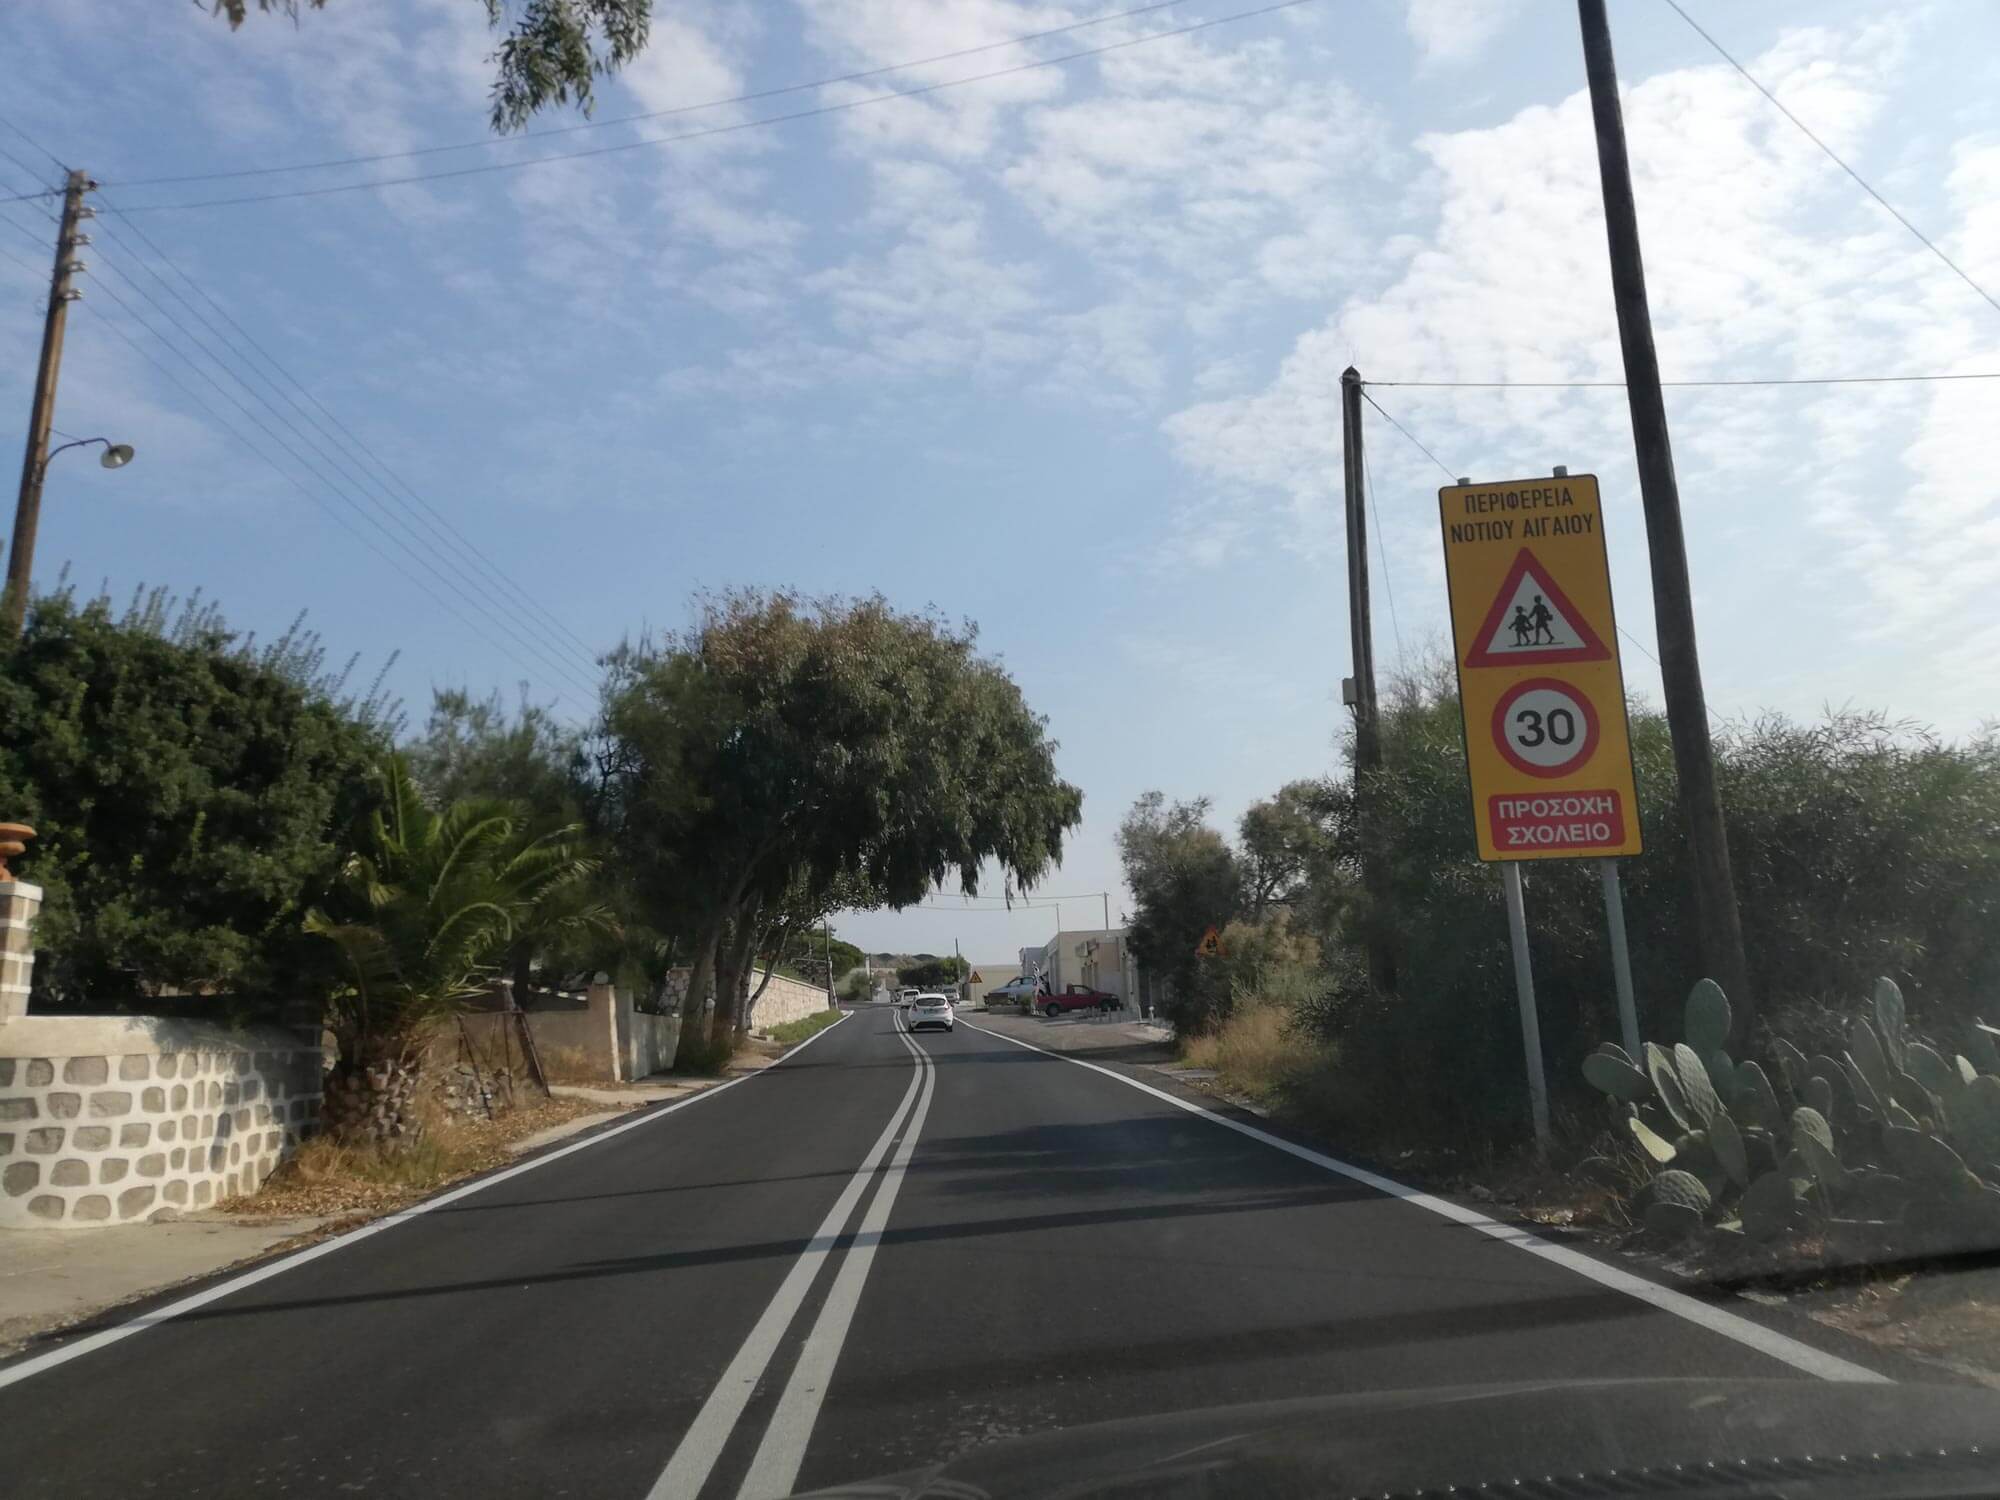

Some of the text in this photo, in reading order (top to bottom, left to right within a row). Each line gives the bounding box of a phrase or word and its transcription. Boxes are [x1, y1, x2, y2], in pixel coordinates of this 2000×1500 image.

[1464, 487, 1574, 514] ΠΕΡΙΦΕΡΕΙΑ
[1450, 513, 1593, 544] ΝΟΤΙΟΥ ΑΙΓΑΙΟΥ
[1516, 708, 1576, 748] 30
[1498, 796, 1614, 819] ΠΡΟΣΟΧΗ
[1506, 822, 1611, 845] ΣΧΟΛΕΙΟ
